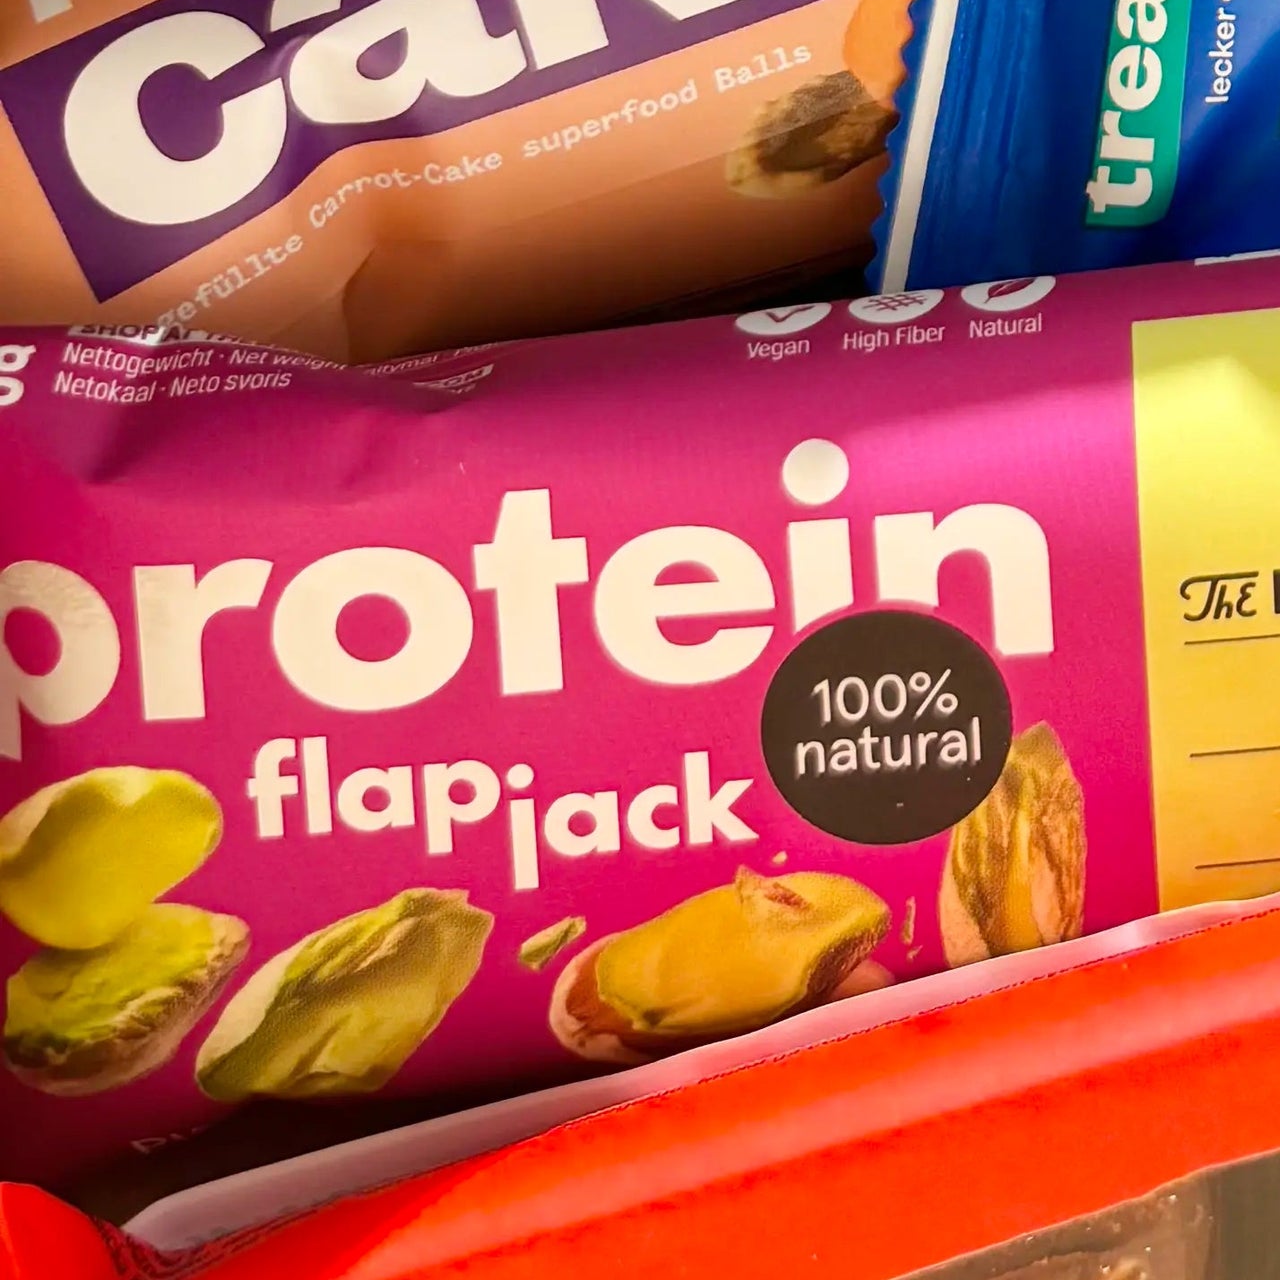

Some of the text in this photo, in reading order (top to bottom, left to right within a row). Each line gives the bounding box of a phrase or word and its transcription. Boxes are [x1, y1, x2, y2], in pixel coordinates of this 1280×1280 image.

[1205, 4, 1237, 104] lecker
[150, 40, 813, 344] gefüllte Carrot-Cake superfood Balls
[746, 338, 810, 359] Vegan
[841, 321, 945, 353] High Fiber
[967, 313, 1043, 339] Natural
[53, 371, 156, 403] Netokaal
[170, 372, 220, 398] Neto
[225, 371, 292, 393] svoris
[61, 341, 214, 379] Nettogewicht
[230, 349, 270, 365] Net
[0, 438, 1055, 762] protein
[1179, 570, 1259, 623] The
[811, 668, 959, 725] 100%
[794, 717, 983, 779] natural
[247, 735, 760, 891] flapjack
